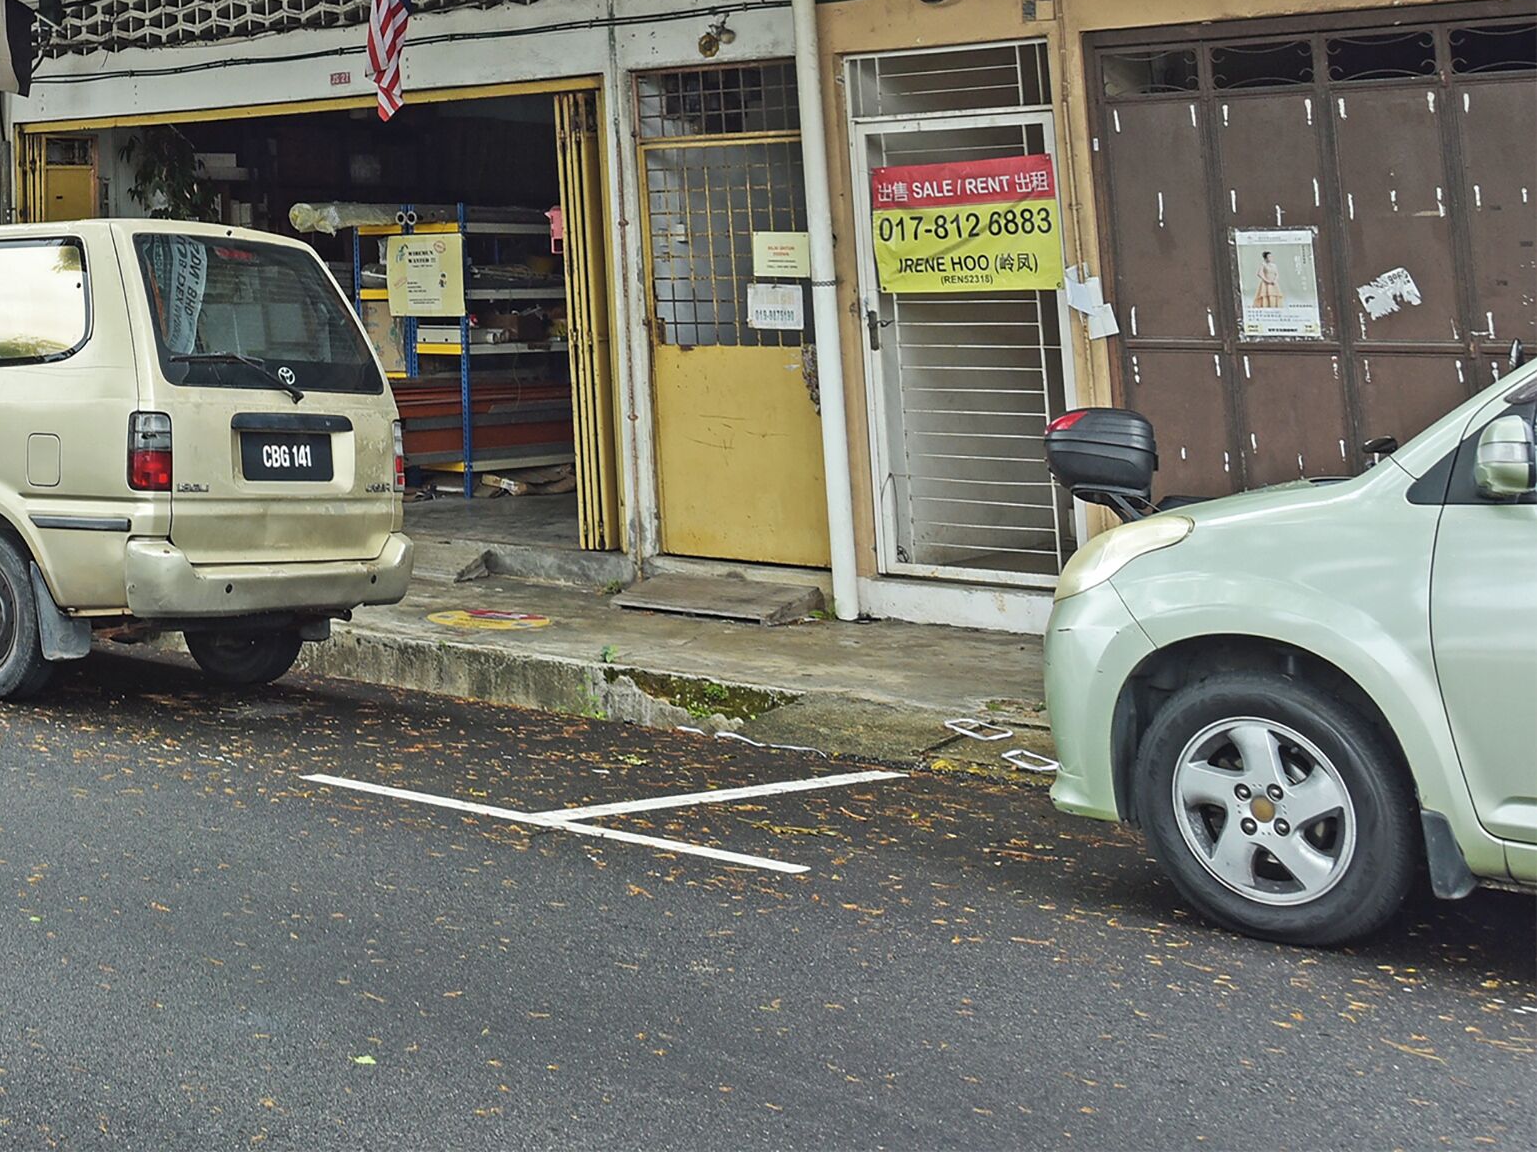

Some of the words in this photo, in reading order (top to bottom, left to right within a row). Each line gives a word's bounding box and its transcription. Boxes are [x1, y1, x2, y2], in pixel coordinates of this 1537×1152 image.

[878, 181, 909, 203] 出售
[913, 179, 953, 198] SALE
[965, 175, 1010, 194] RENT
[1015, 170, 1049, 193] 出租
[879, 212, 981, 243] 017-812
[988, 207, 1052, 237] 6883
[898, 256, 947, 274] IRENE
[951, 254, 990, 272] HOO
[263, 445, 290, 468] CBG
[292, 444, 312, 467] 141
